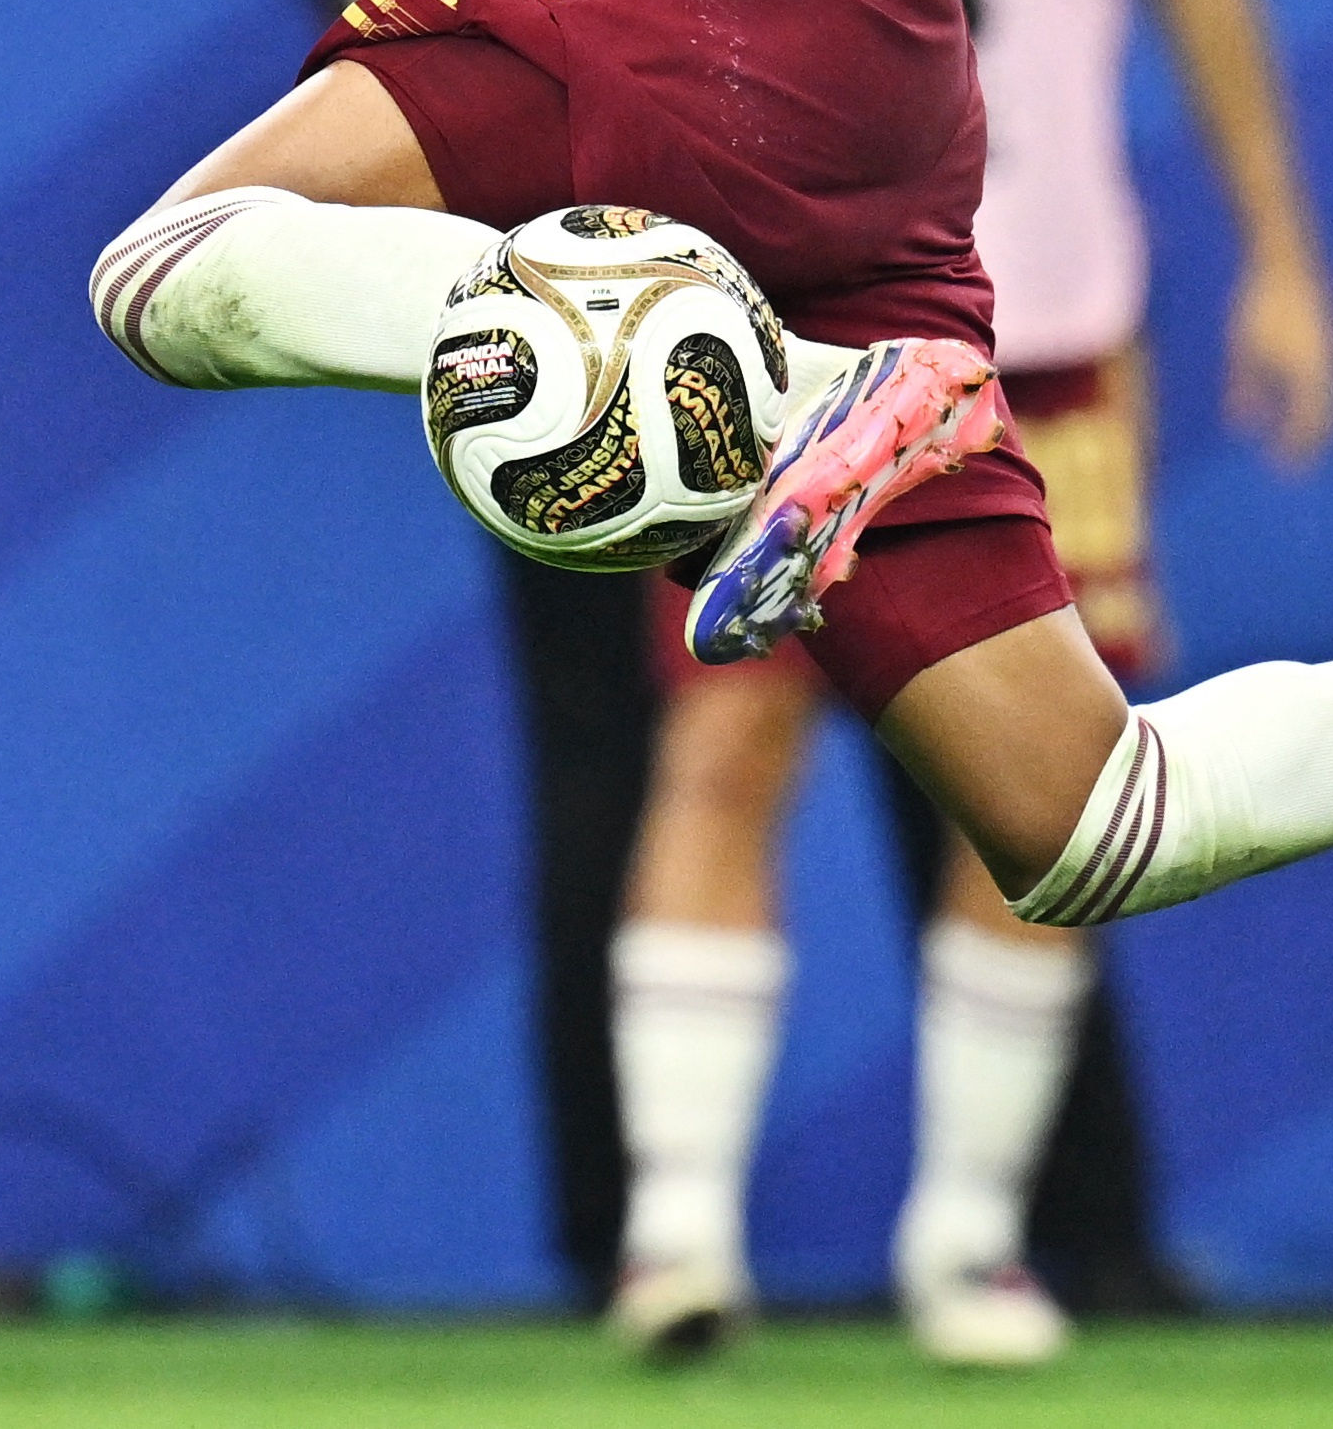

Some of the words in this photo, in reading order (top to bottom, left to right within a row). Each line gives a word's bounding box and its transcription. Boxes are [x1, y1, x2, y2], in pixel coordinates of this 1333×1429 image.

[437, 341, 514, 370] TRIONDA
[455, 358, 514, 381] FINAL
[677, 369, 755, 479] DALLAS
[558, 416, 623, 491] JERSEY
